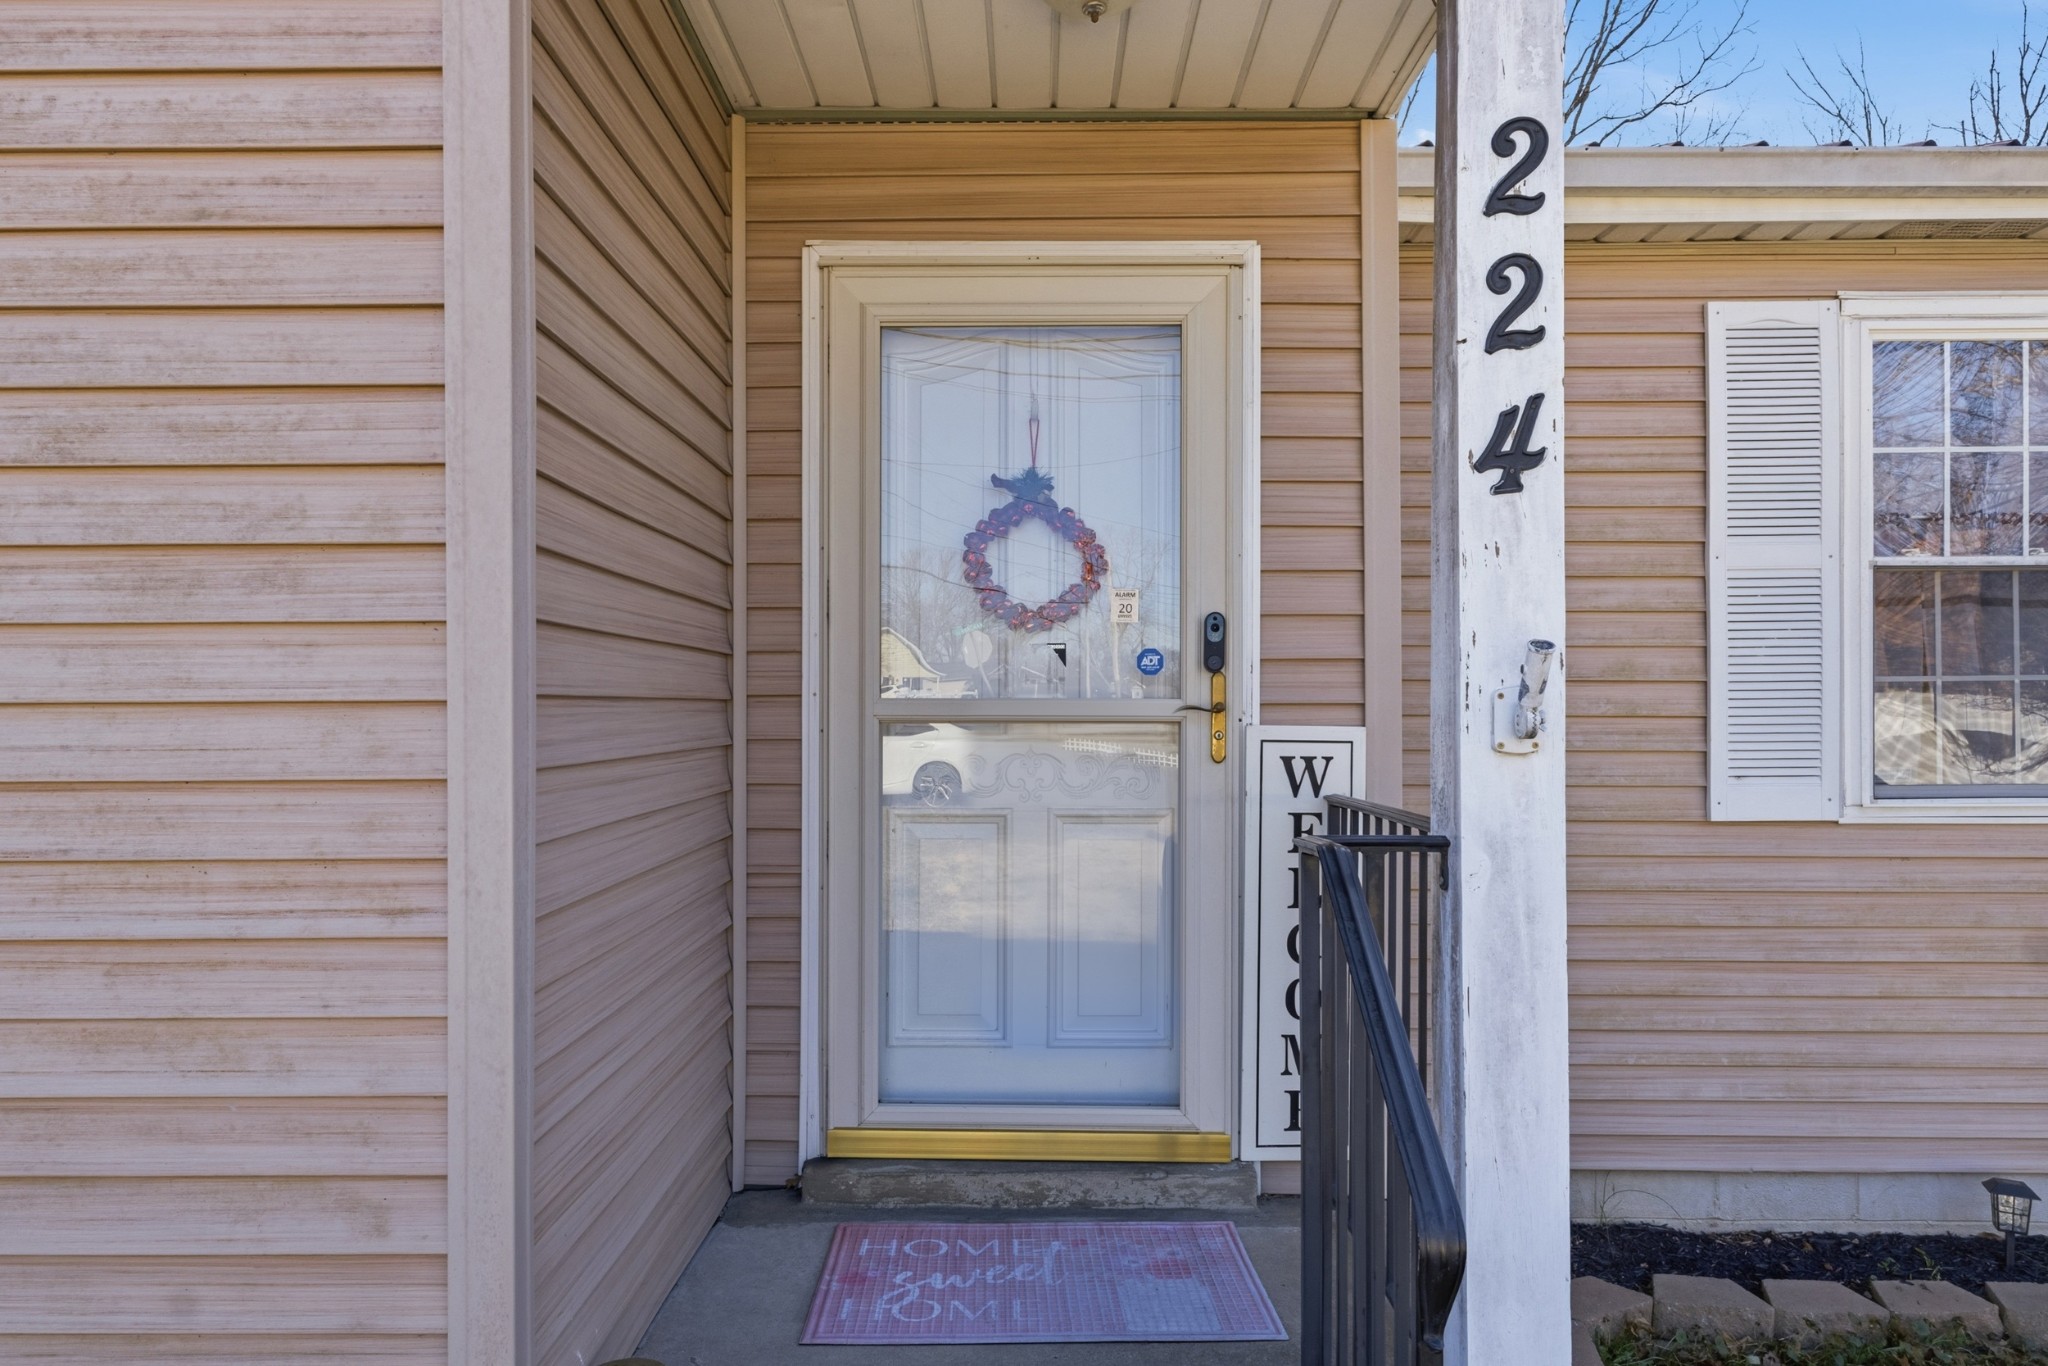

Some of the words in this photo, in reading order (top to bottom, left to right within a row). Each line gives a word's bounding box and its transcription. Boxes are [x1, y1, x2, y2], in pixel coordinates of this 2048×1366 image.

[1474, 116, 1550, 496] 224
[1118, 603, 1133, 614] 20
[1140, 655, 1161, 666] ADT
[858, 1238, 1038, 1257] HOME
[880, 1240, 1069, 1306] sweet
